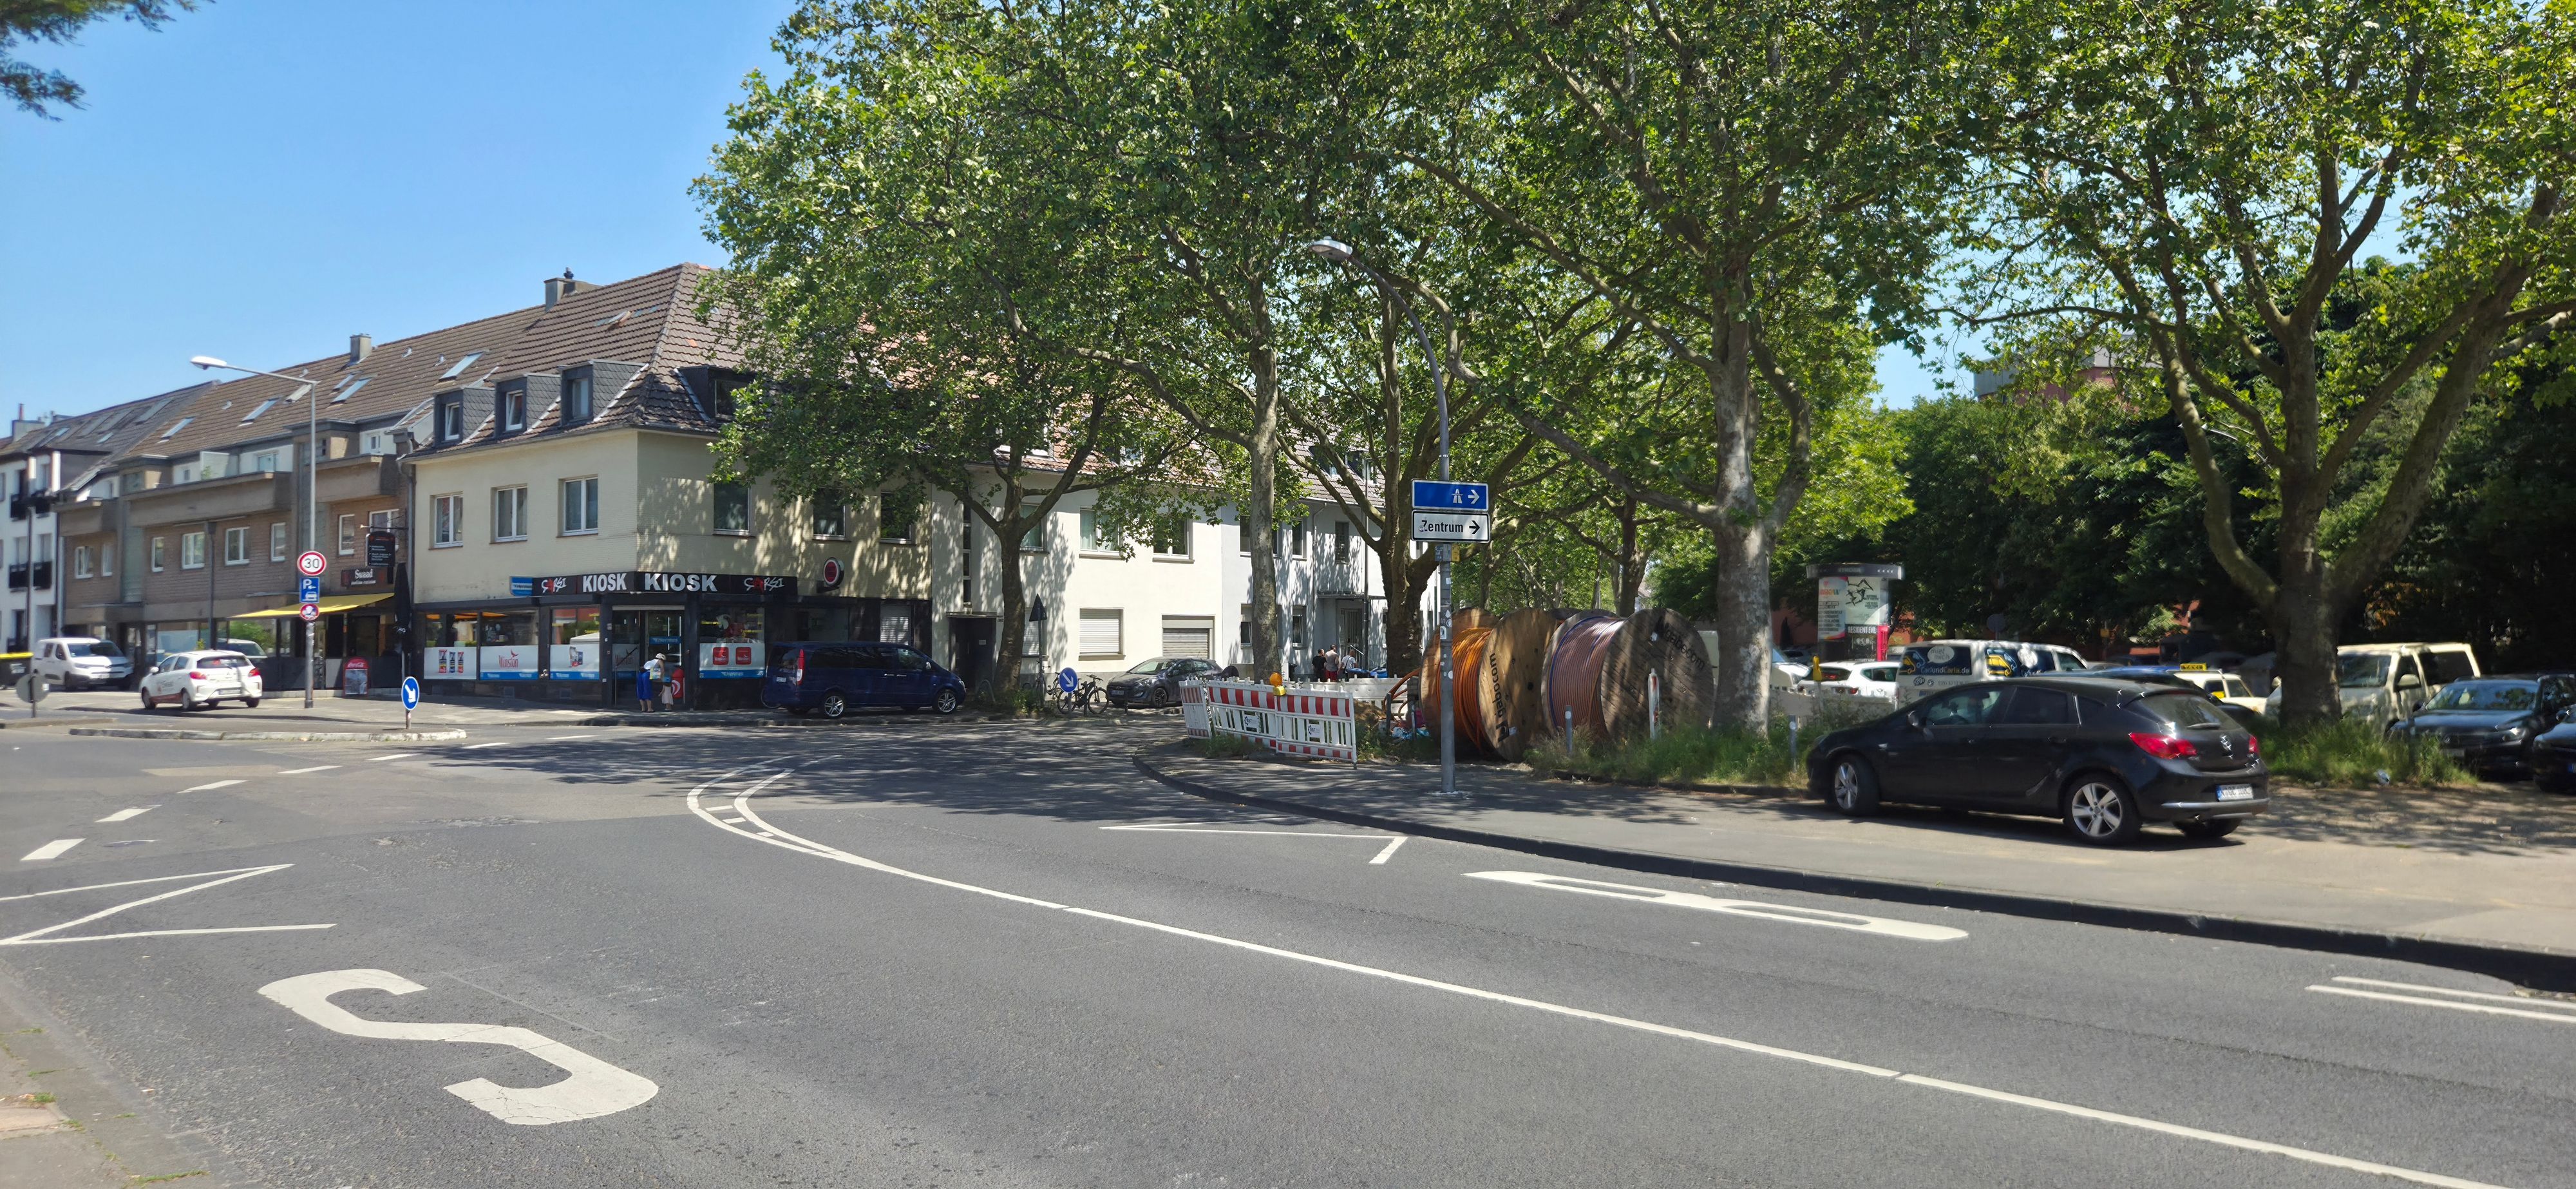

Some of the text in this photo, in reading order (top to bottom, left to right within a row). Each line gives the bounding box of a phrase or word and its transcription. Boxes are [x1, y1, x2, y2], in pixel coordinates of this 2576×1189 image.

[1419, 520, 1463, 533] Zentrum
[304, 558, 320, 569] 30
[303, 579, 312, 589] P
[583, 573, 627, 593] KIOSK
[644, 573, 717, 592] KIOSK
[498, 655, 518, 669] Winston
[1489, 652, 1507, 718] gabocom
[258, 968, 658, 1125] S
